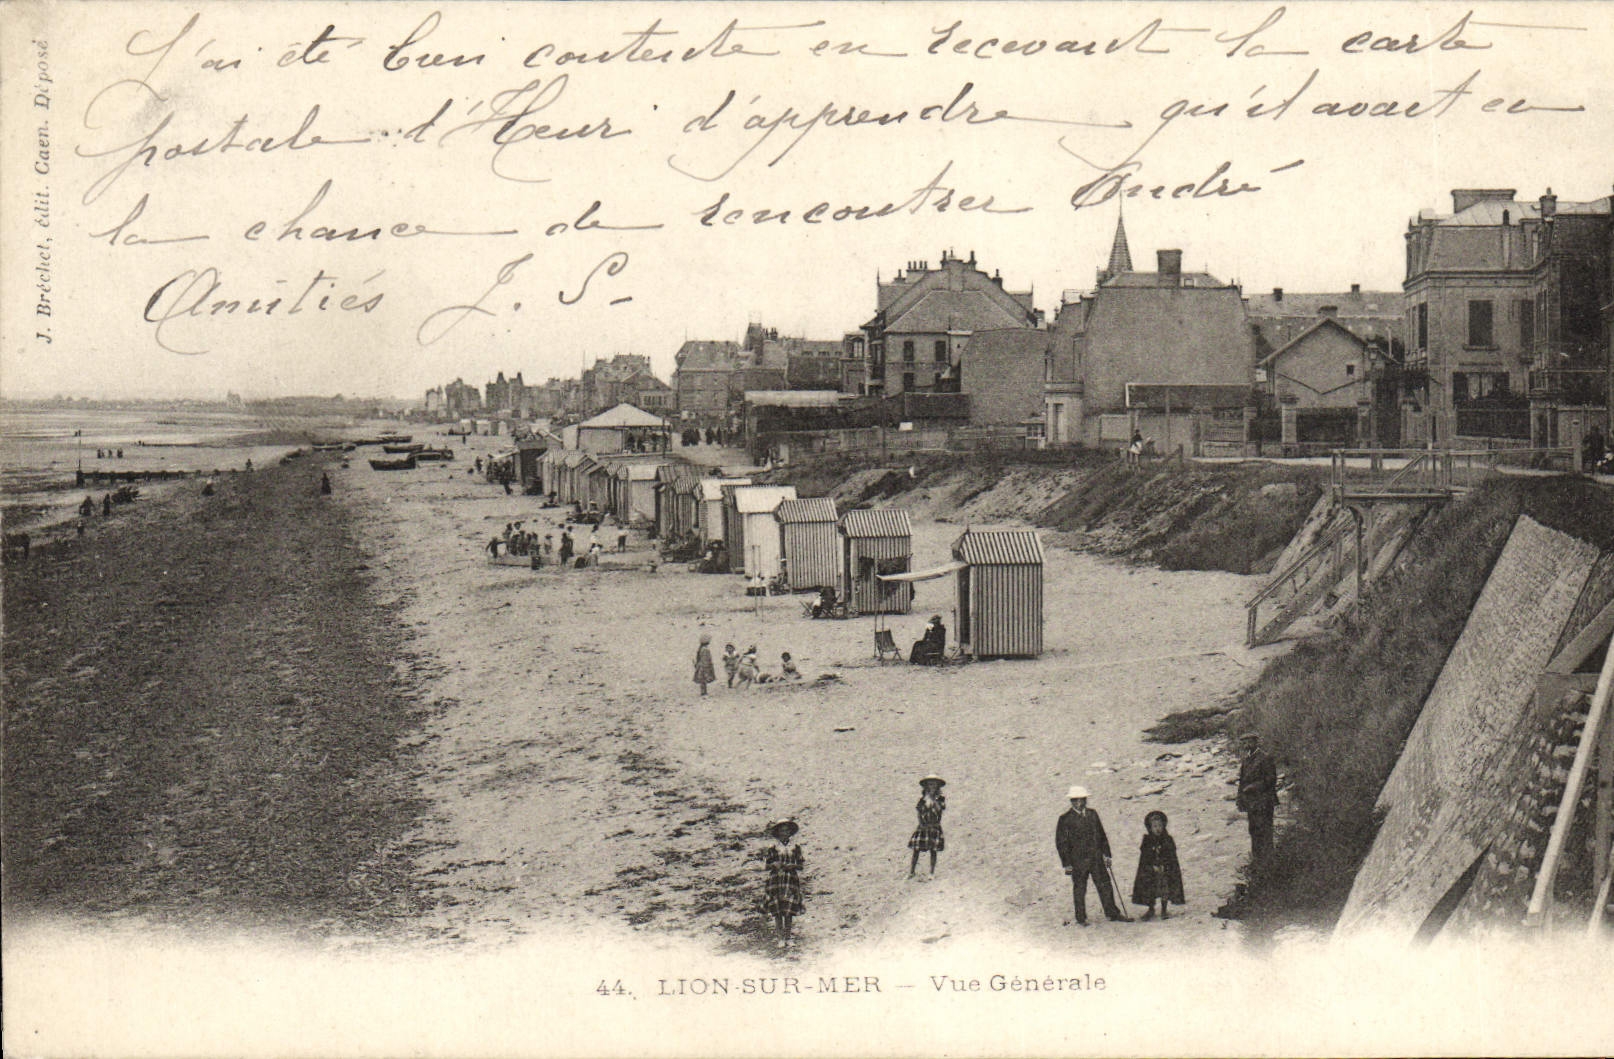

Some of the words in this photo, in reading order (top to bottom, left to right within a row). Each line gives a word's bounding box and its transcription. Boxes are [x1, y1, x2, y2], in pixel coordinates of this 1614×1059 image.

[276, 24, 366, 68] été
[383, 11, 505, 72] bien
[523, 17, 825, 68] contente
[812, 39, 908, 57] en
[927, 17, 1211, 58] recevant
[1215, 6, 1309, 58] la
[1341, 11, 1587, 55] carte
[74, 104, 372, 206] postale
[667, 82, 1133, 182] d'apprendre
[1058, 69, 1319, 172] qu'il
[1311, 69, 1481, 119] avait
[89, 193, 209, 246] la
[244, 178, 517, 242] chance
[546, 200, 664, 236] de
[692, 160, 1034, 226] rencontrer
[1070, 159, 1304, 211] André
